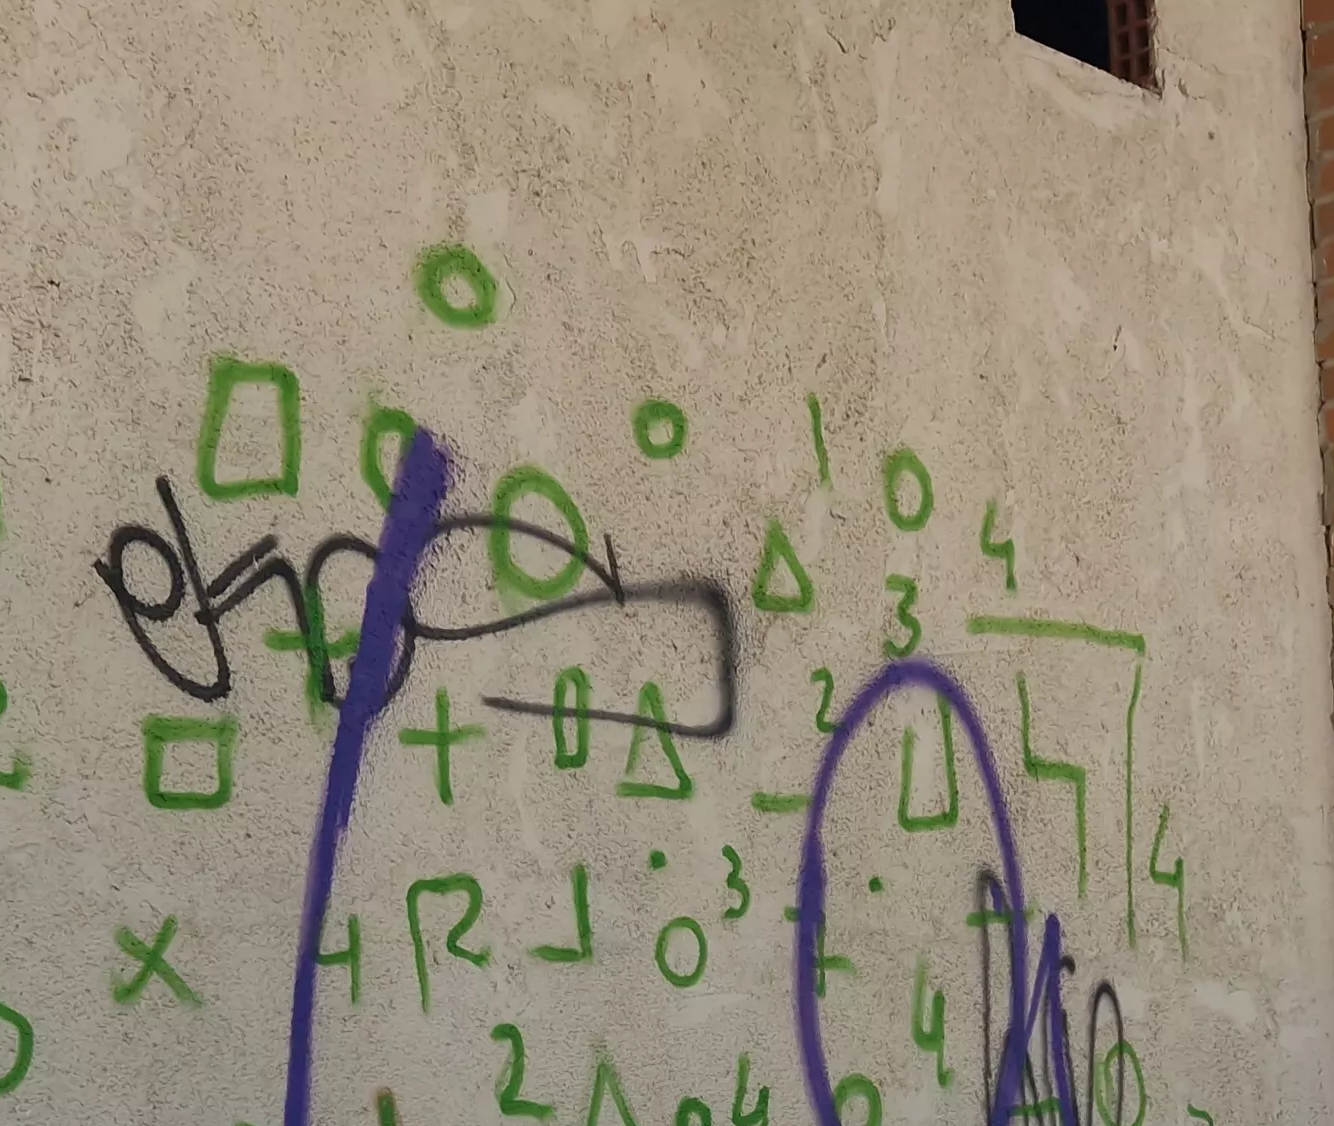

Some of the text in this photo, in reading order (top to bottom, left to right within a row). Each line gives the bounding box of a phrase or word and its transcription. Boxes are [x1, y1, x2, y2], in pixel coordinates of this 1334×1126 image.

[888, 577, 921, 655] 3
[723, 846, 750, 920] 3
[1148, 806, 1191, 960] 4
[492, 1024, 555, 1119] 2
[912, 958, 955, 1090] 4
